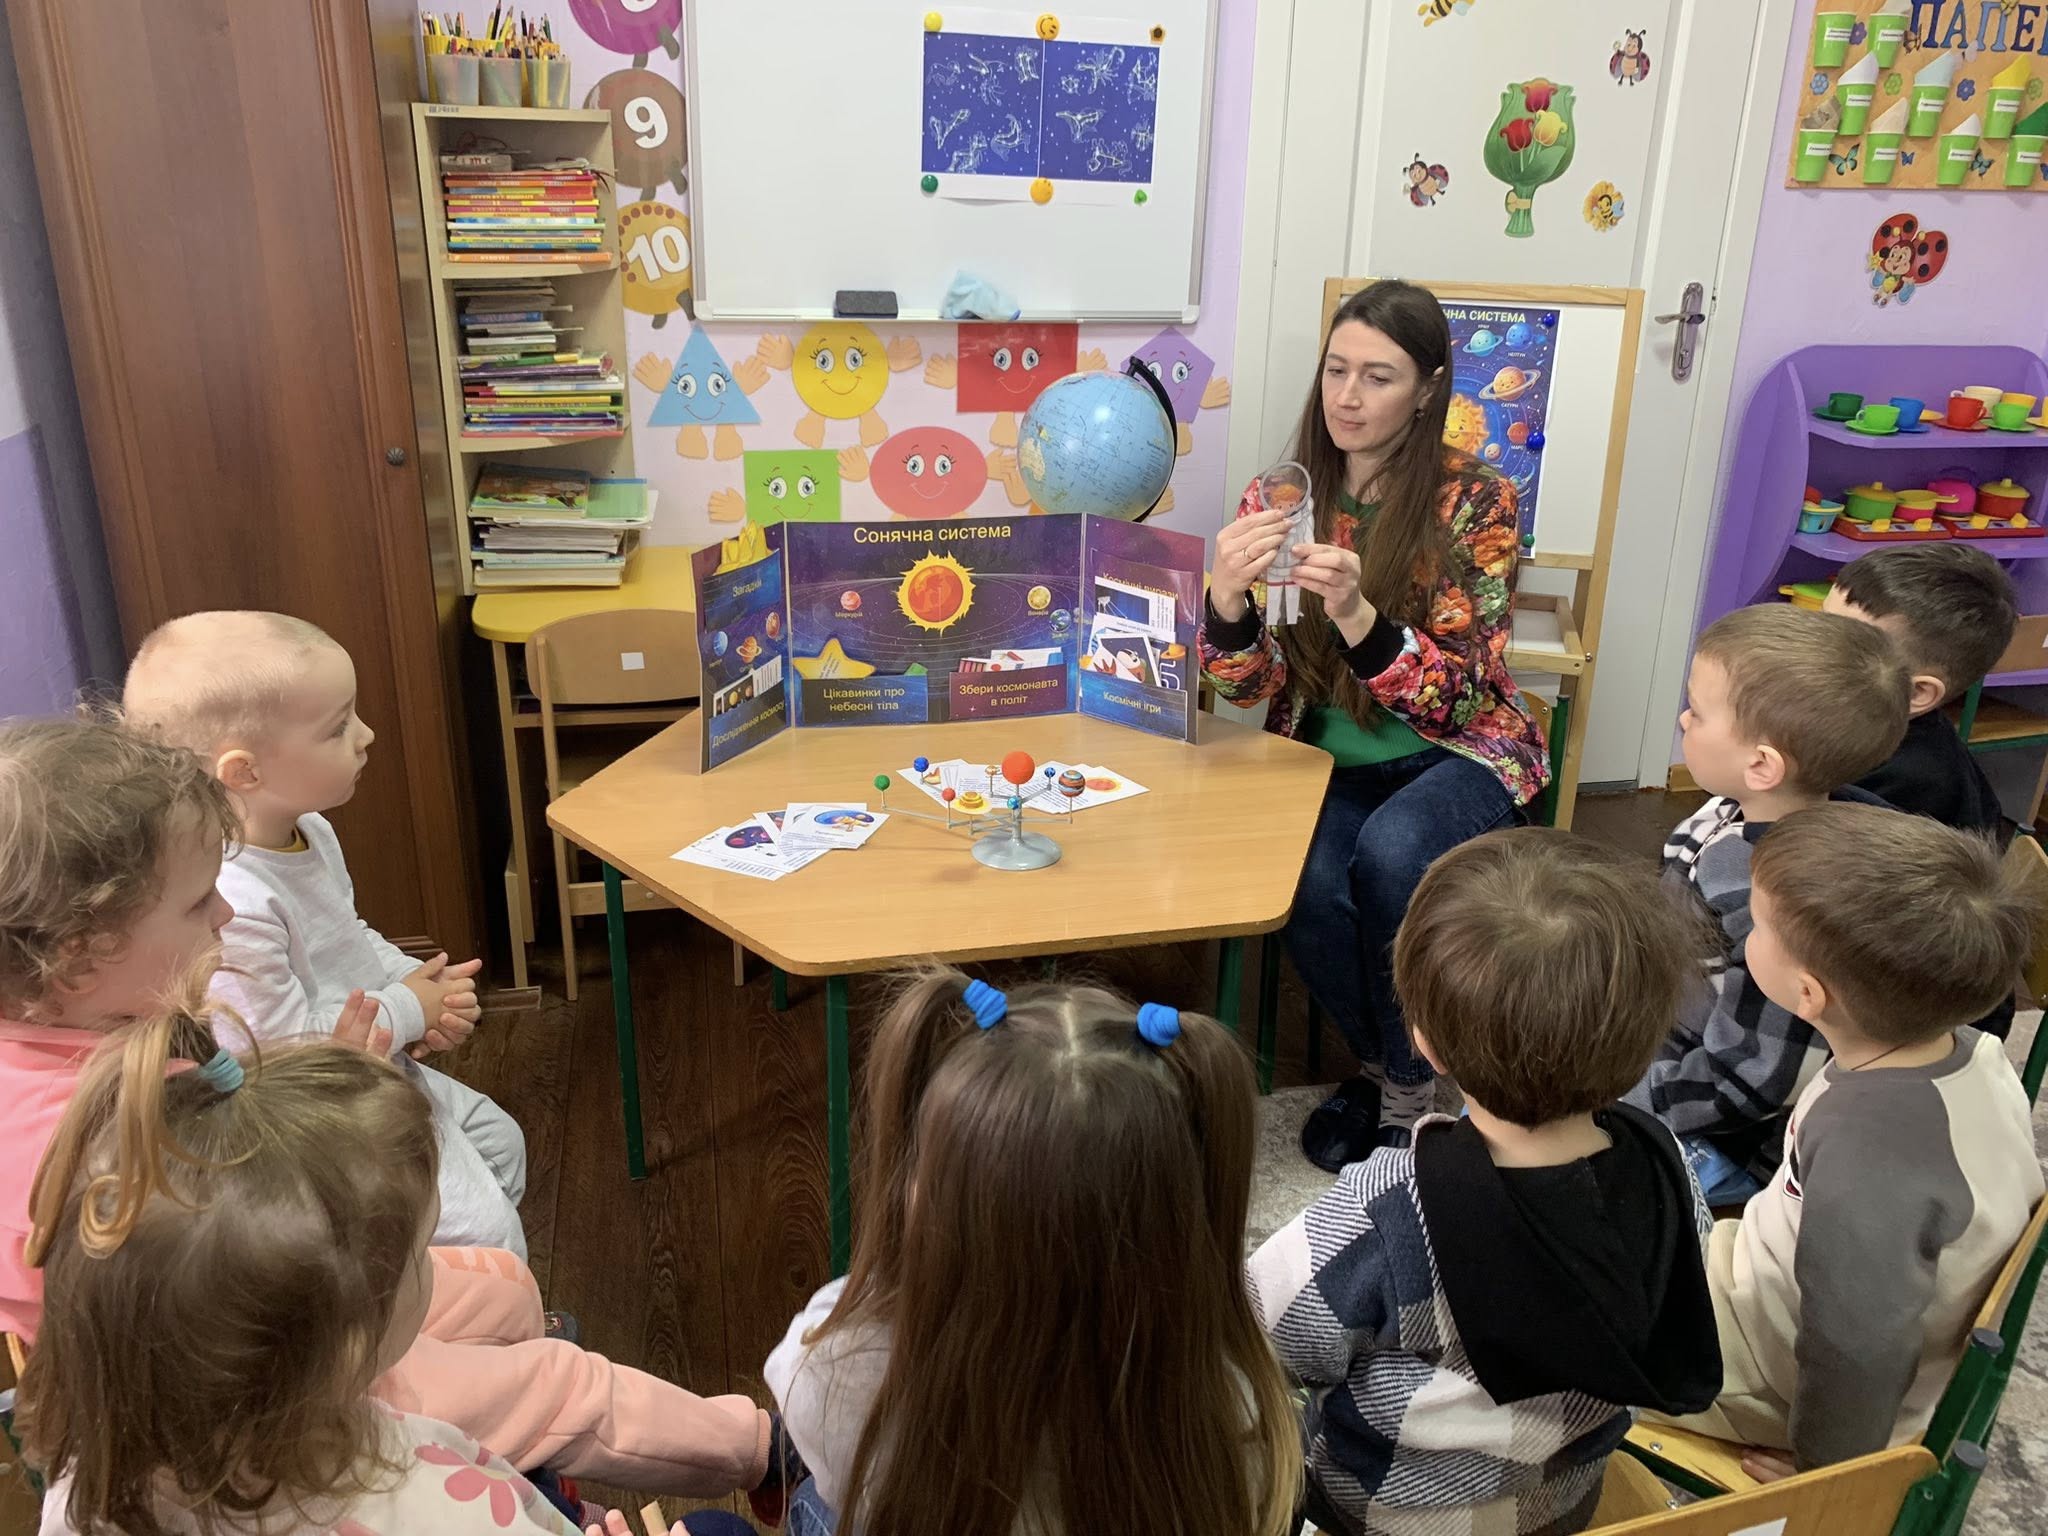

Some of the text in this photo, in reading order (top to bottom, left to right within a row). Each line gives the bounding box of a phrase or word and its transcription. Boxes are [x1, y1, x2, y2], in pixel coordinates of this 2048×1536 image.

[1911, 0, 2048, 55] ПАПЕ
[624, 96, 669, 149] 9
[626, 226, 691, 282] 10
[1469, 310, 1526, 323] СИСТЕМА
[853, 525, 1011, 543] Сонячна система
[823, 688, 905, 699] Цікавинки про
[959, 679, 1058, 695] Збери космонавта
[830, 701, 899, 711] небесні тіла
[991, 695, 1028, 706] в політ
[1103, 690, 1161, 714] Космічні ігри
